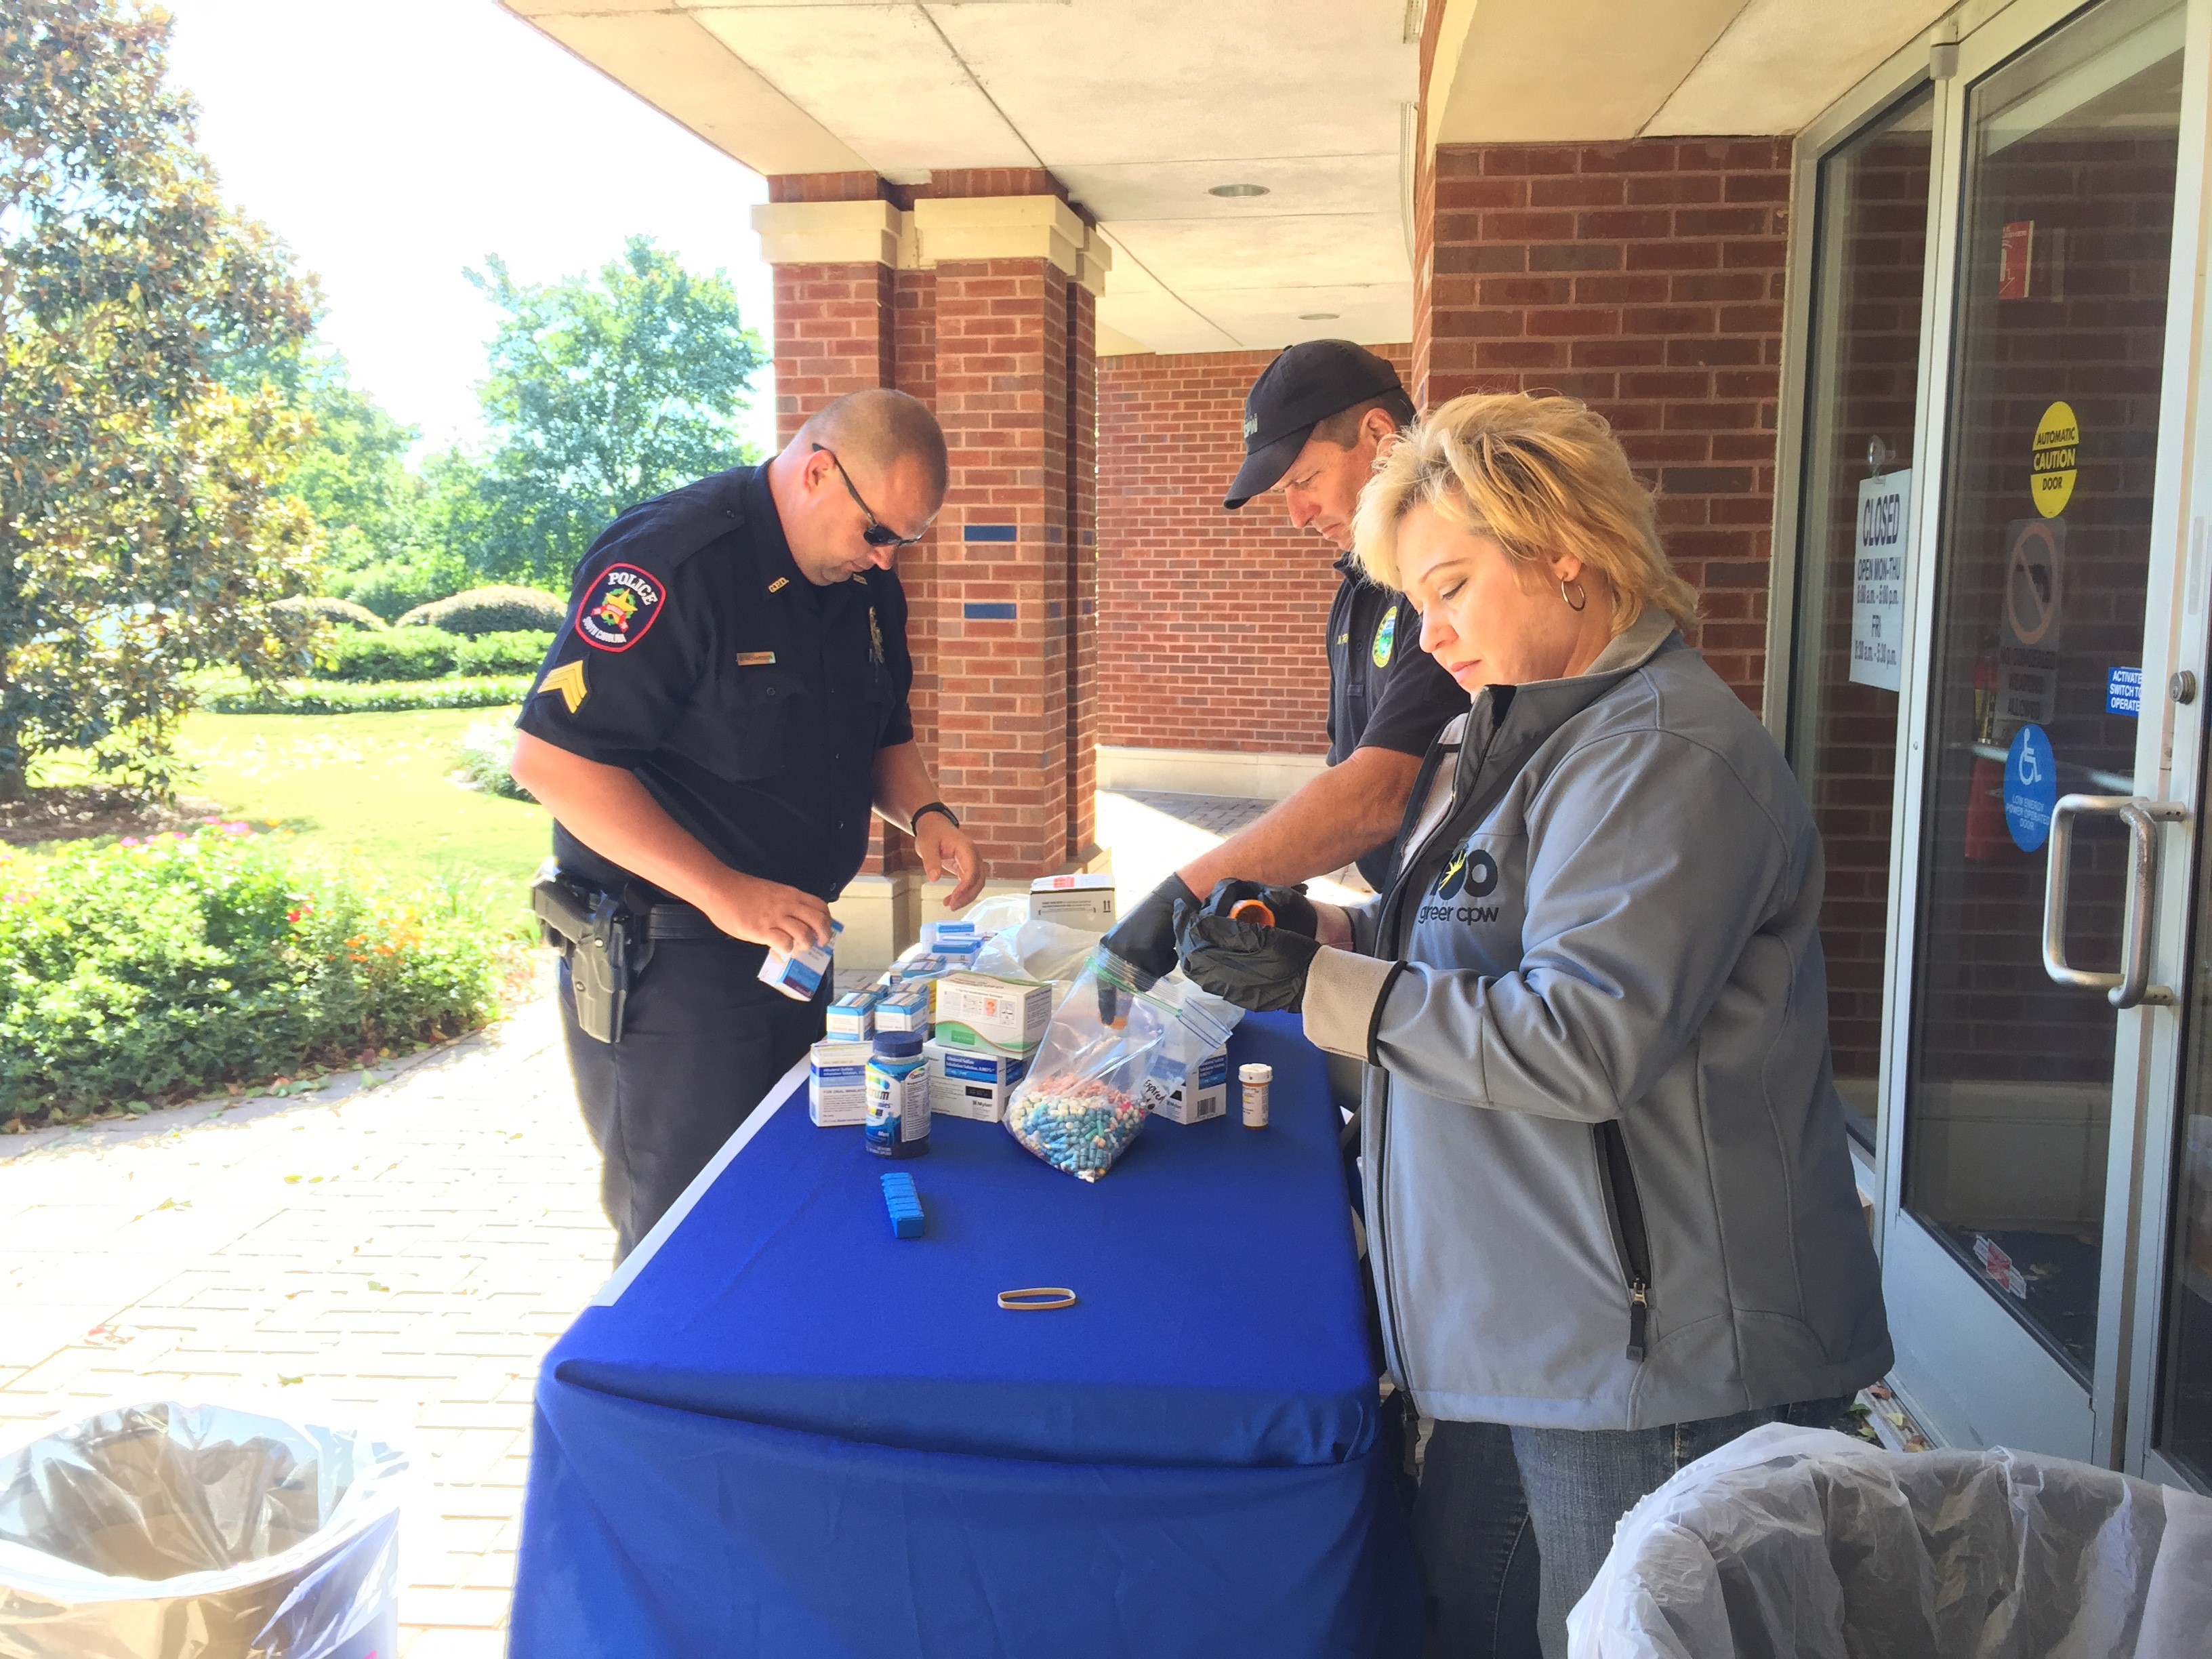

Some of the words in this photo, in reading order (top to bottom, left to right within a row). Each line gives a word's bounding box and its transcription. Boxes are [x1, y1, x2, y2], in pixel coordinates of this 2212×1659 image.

[2036, 427, 2075, 445] AUTOMATIC
[2034, 448, 2075, 471] CAUTION
[2042, 476, 2062, 491] DOOR
[1863, 493, 1900, 546] CLOSED
[1858, 558, 1874, 581] OPEN
[1874, 557, 1900, 581] MON-THU
[608, 572, 658, 605] POLICE
[1871, 615, 1881, 637] FRI
[2112, 670, 2142, 684] ACTIVATE
[2110, 683, 2134, 697] SWITCH
[2110, 697, 2140, 712] OPERATE
[2012, 794, 2023, 806] LOW
[2020, 817, 2034, 831] DOOR
[1418, 905, 1454, 924] greer
[1456, 907, 1499, 926] cpw
